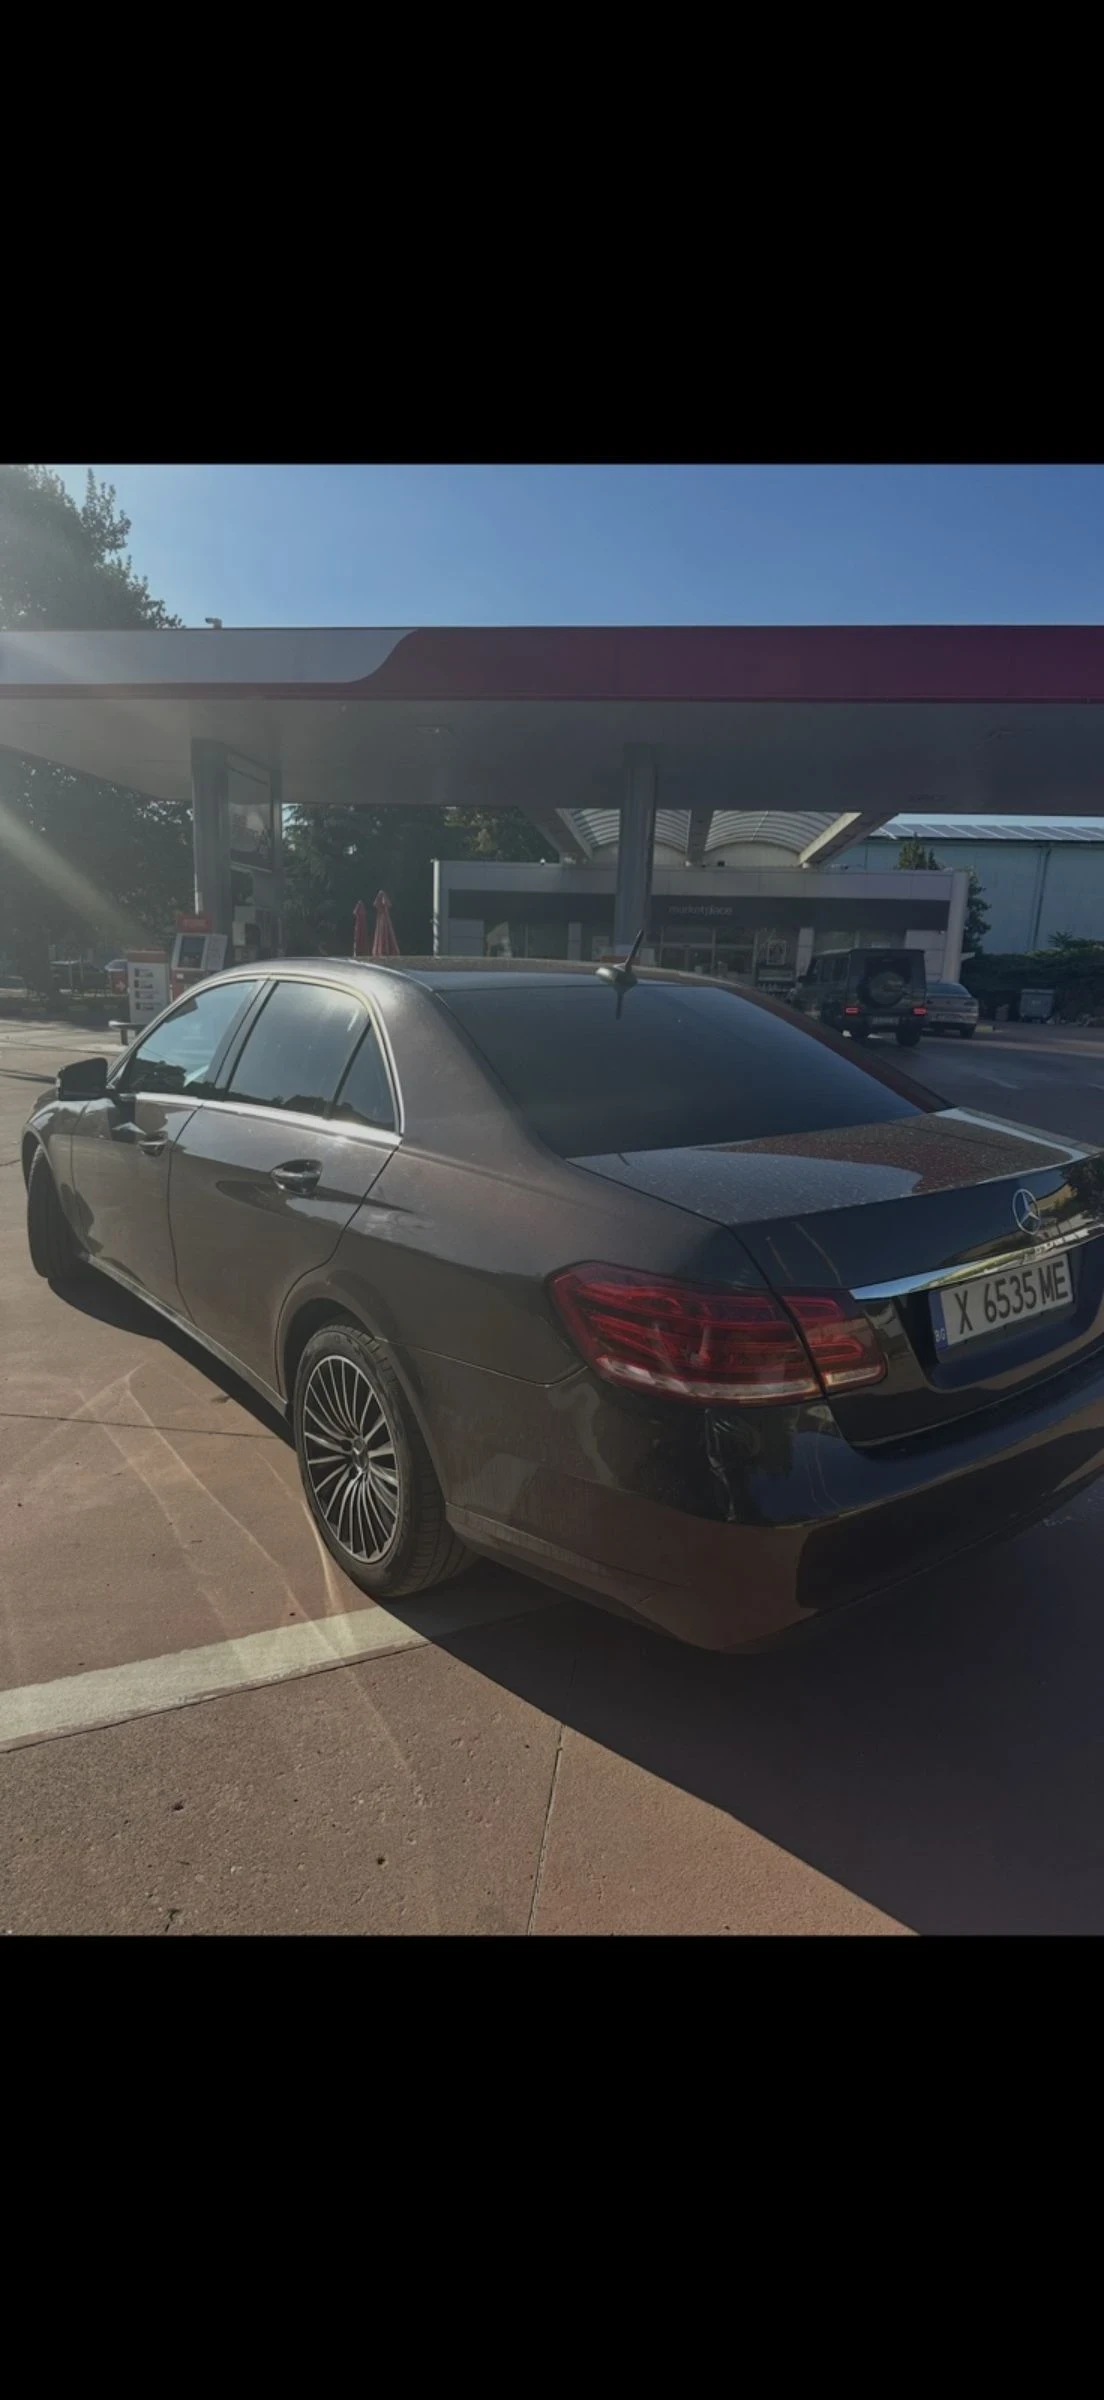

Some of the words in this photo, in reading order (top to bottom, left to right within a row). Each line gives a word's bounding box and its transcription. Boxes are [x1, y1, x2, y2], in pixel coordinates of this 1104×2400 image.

[668, 904, 734, 917] marketplace
[953, 1290, 973, 1335] X
[983, 1271, 1038, 1323] 6535
[1038, 1261, 1070, 1305] ME
[934, 1328, 946, 1342] BG
